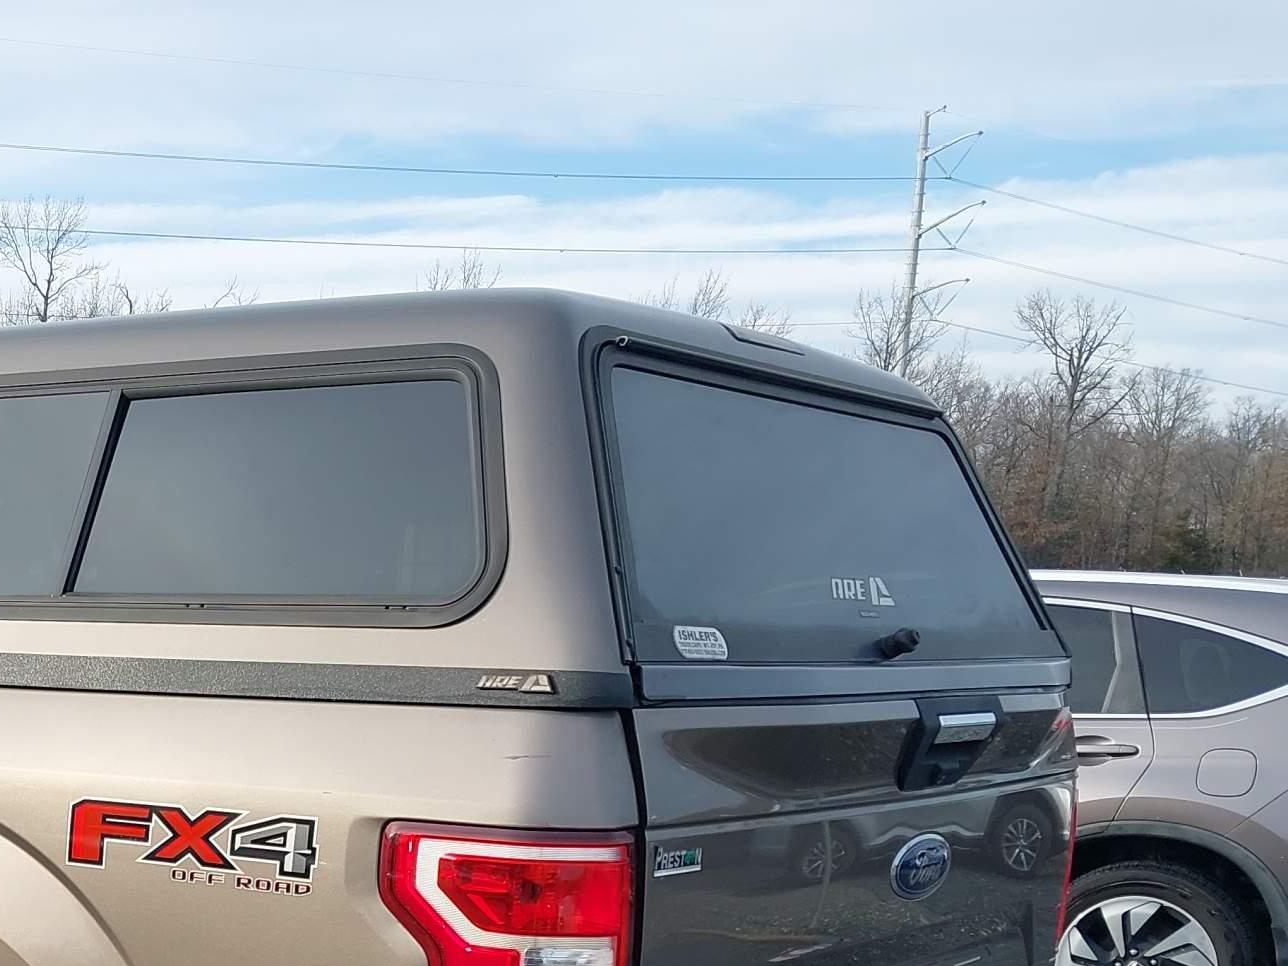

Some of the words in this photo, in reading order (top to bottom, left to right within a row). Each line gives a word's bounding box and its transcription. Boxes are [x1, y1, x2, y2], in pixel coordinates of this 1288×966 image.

[67, 797, 318, 881] FX4
[171, 868, 224, 884] OFF
[234, 876, 312, 896] ROAD
